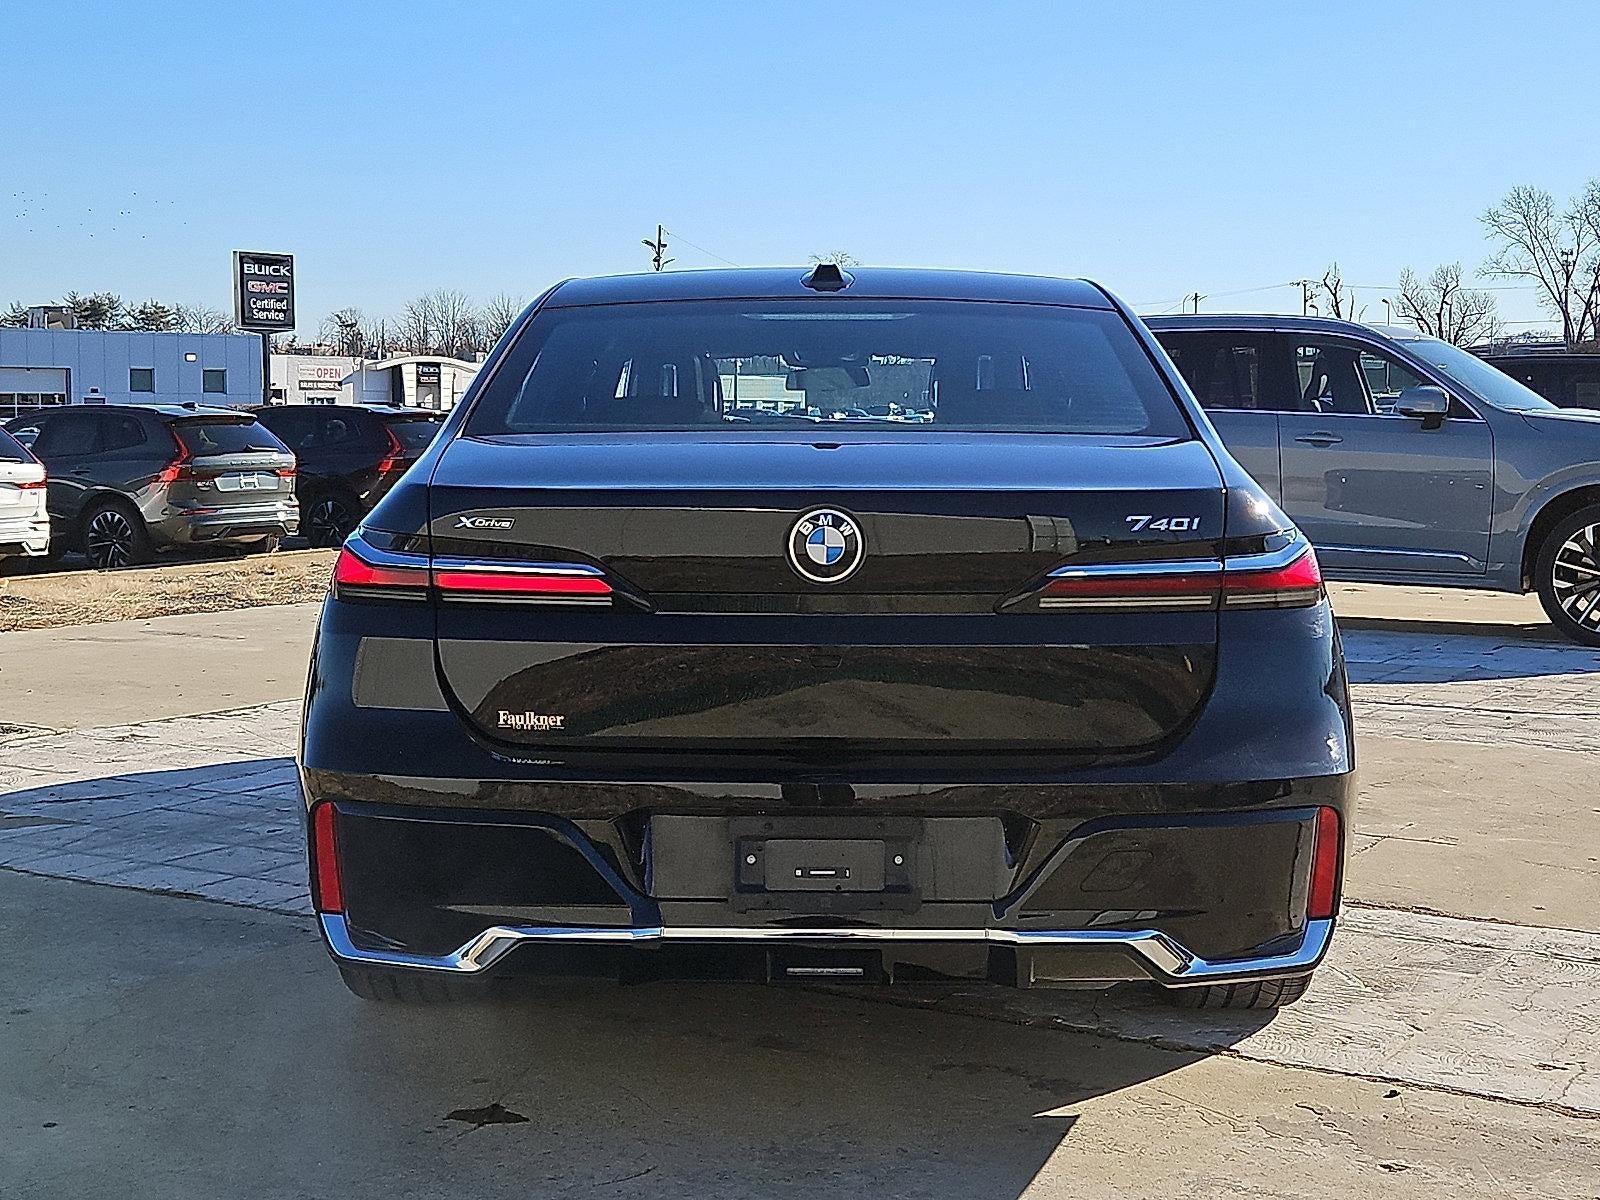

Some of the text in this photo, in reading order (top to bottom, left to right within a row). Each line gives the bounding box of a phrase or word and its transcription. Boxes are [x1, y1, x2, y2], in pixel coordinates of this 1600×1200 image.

[243, 263, 291, 276] BUICK
[247, 280, 288, 293] GMC
[250, 298, 287, 309] Certified
[252, 309, 285, 320] Service
[316, 367, 341, 378] OPEN
[799, 514, 853, 536] BMW
[497, 710, 565, 726] Faulkner
